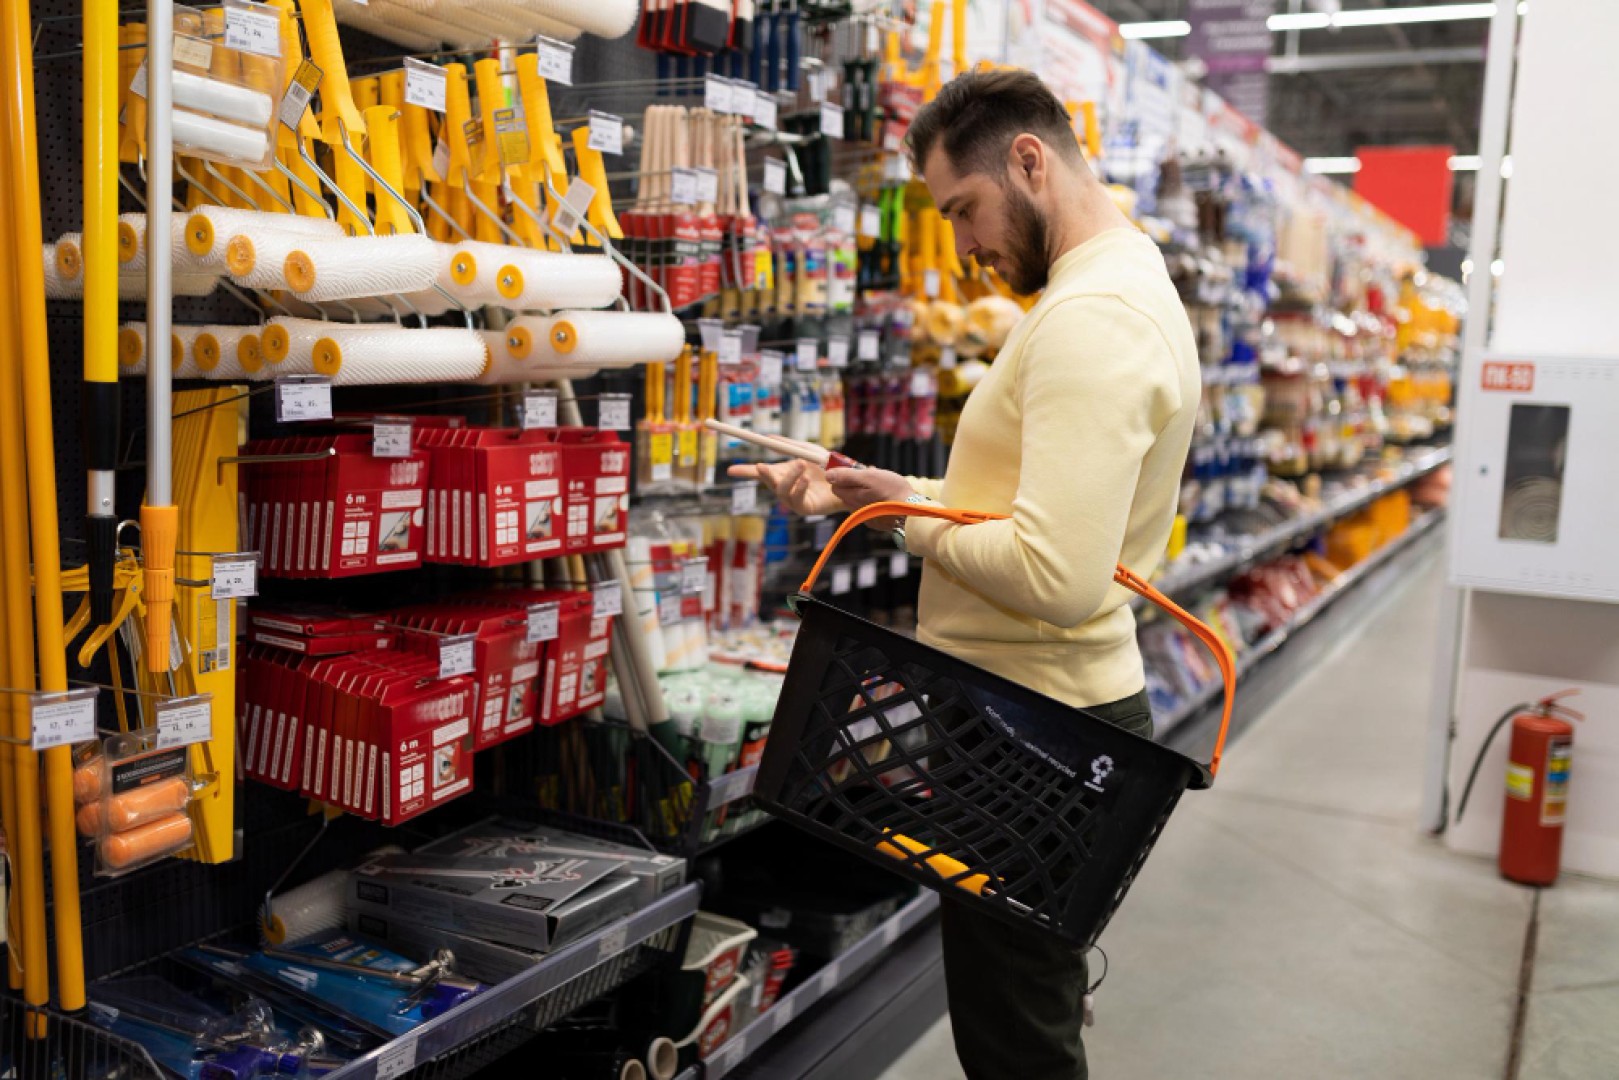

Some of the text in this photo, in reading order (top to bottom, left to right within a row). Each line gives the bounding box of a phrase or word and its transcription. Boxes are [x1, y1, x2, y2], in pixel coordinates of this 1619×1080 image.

[345, 493, 367, 504] 6 m
[399, 739, 419, 753] 6 m
